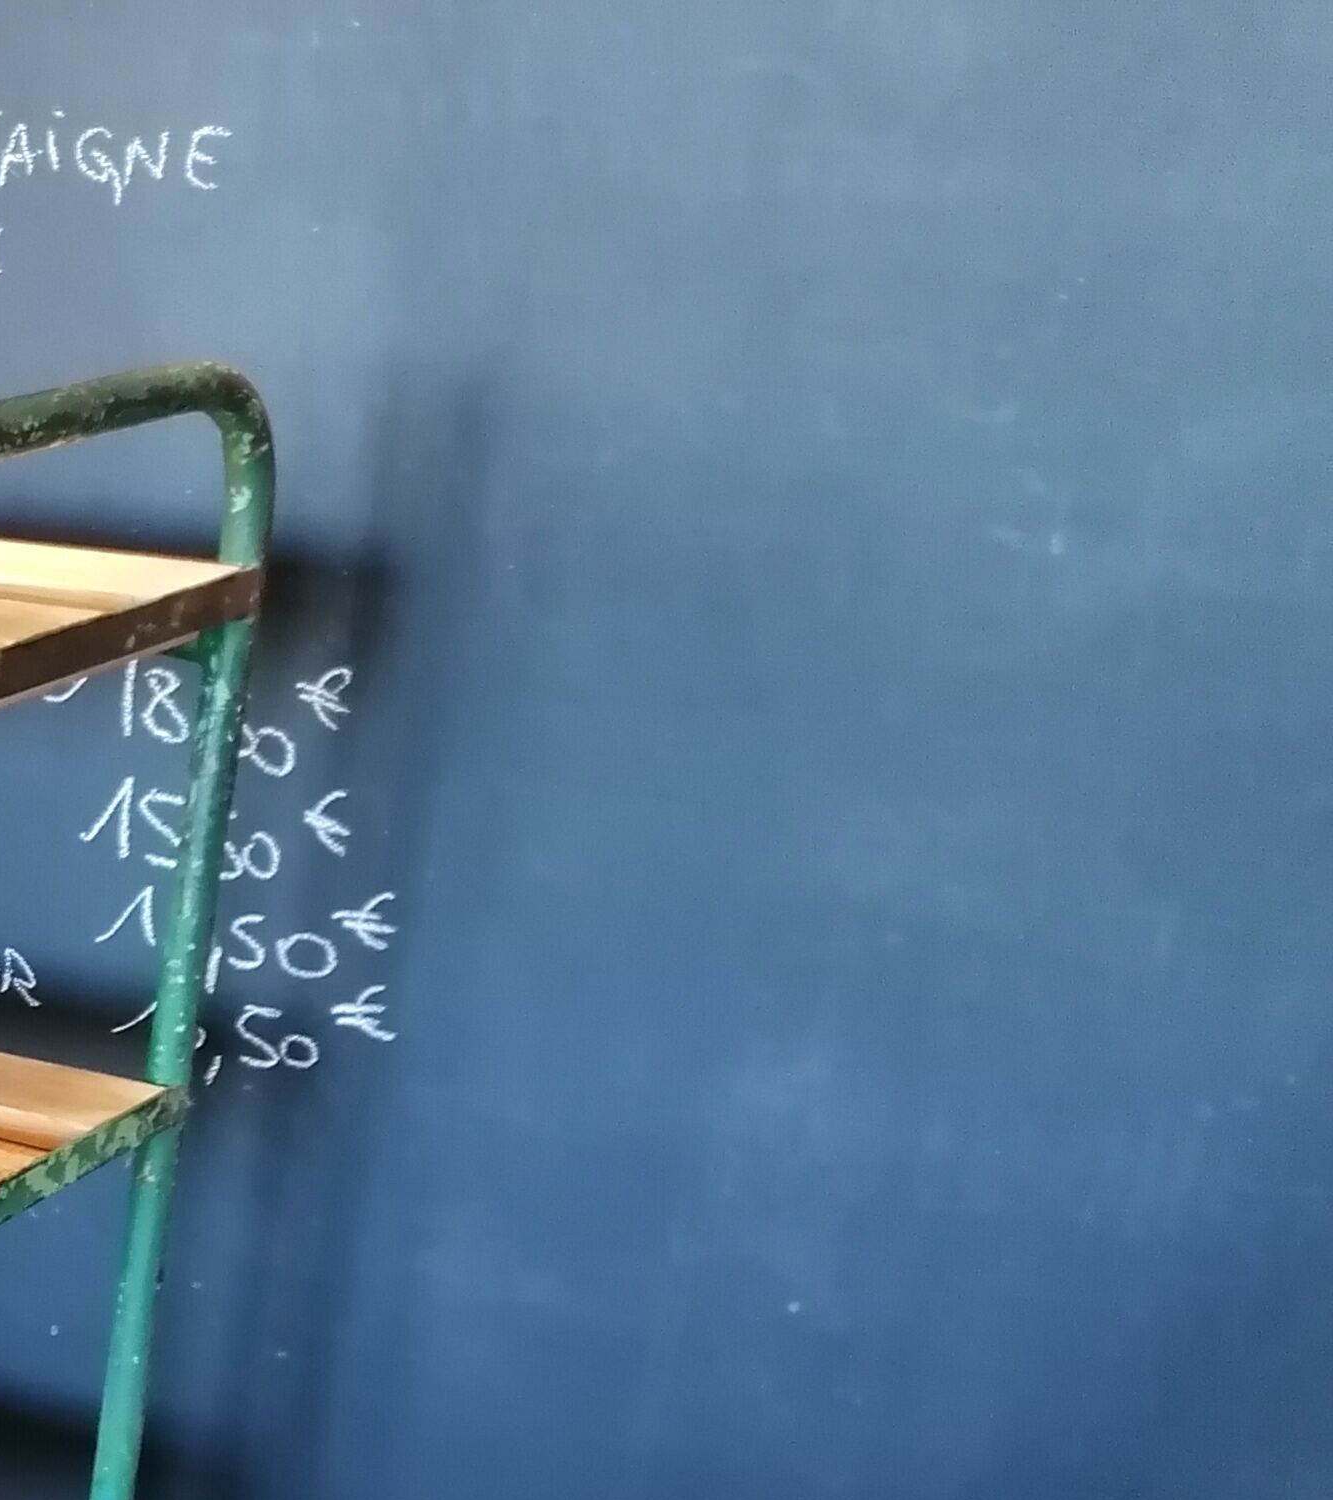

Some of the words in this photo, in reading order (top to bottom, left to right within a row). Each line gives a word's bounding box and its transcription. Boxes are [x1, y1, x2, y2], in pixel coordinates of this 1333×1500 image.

[303, 789, 351, 857] €
[331, 892, 398, 950] €
[329, 985, 397, 1042] €
